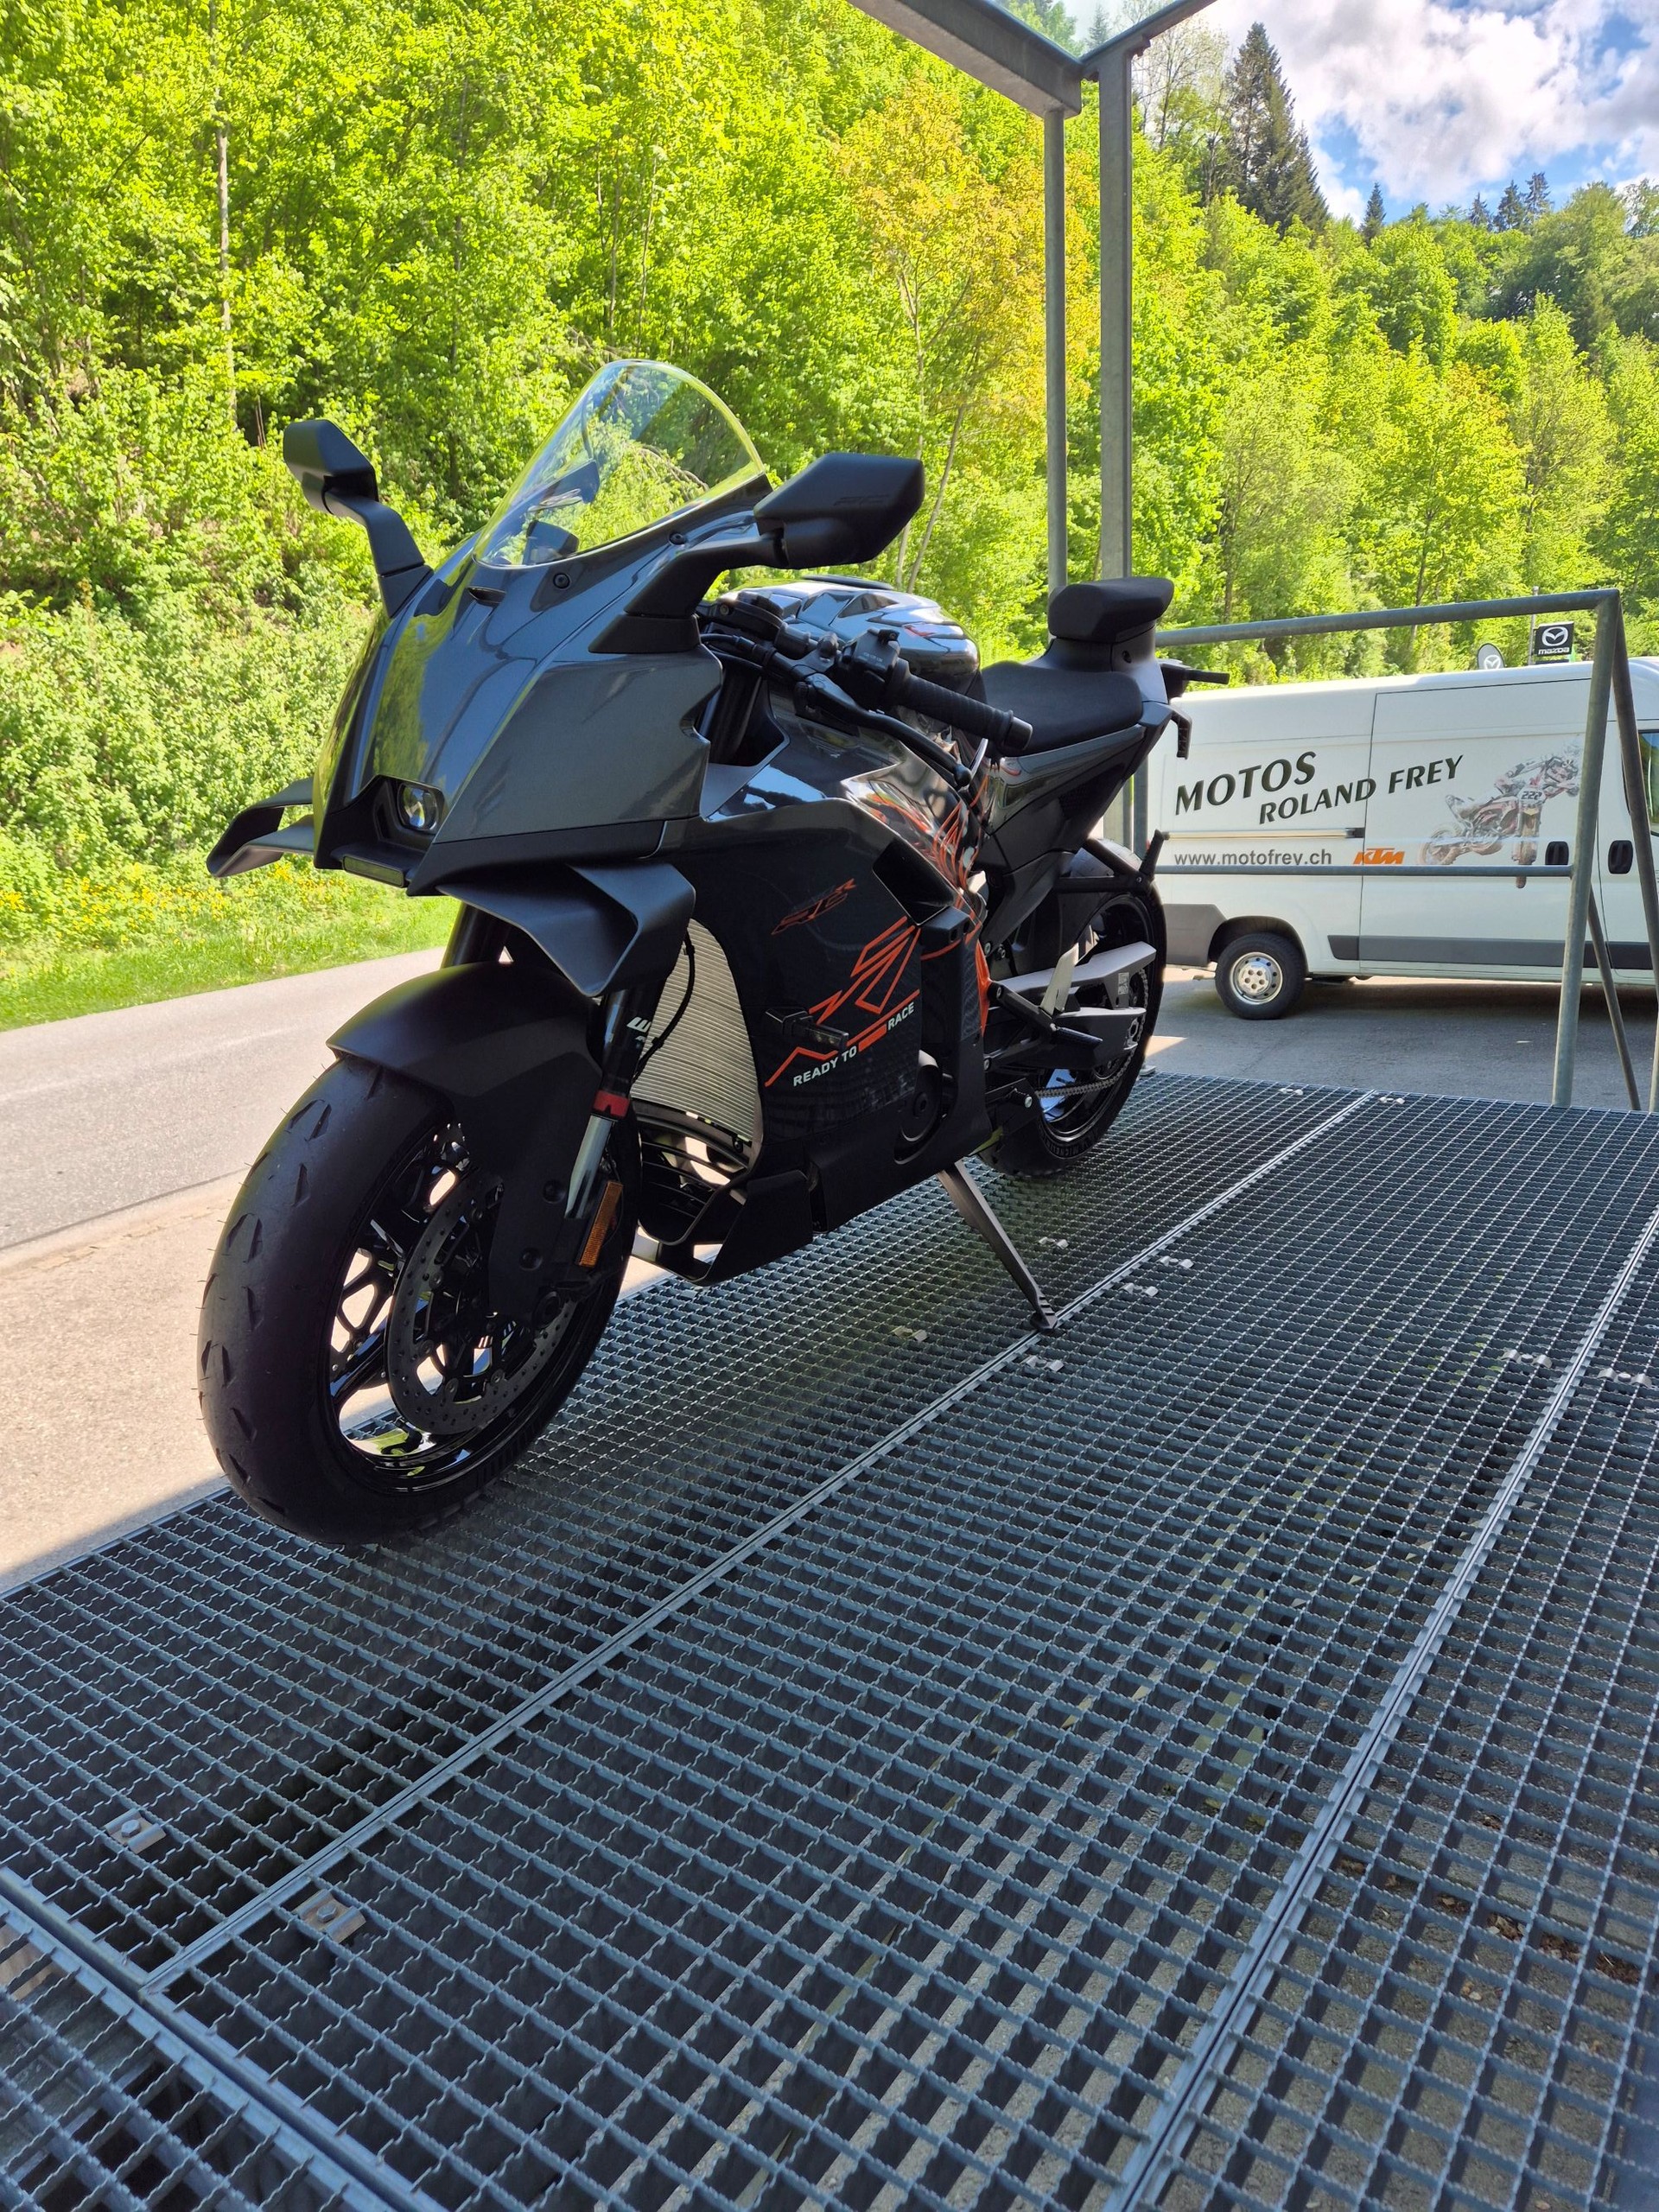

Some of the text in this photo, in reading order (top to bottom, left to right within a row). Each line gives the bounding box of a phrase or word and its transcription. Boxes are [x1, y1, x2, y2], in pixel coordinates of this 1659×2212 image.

[1175, 751, 1317, 816] MOTOS
[1259, 754, 1464, 824] ROLAND FREY
[1353, 848, 1405, 864] KTM
[793, 1001, 914, 1087] READY TO RACE
